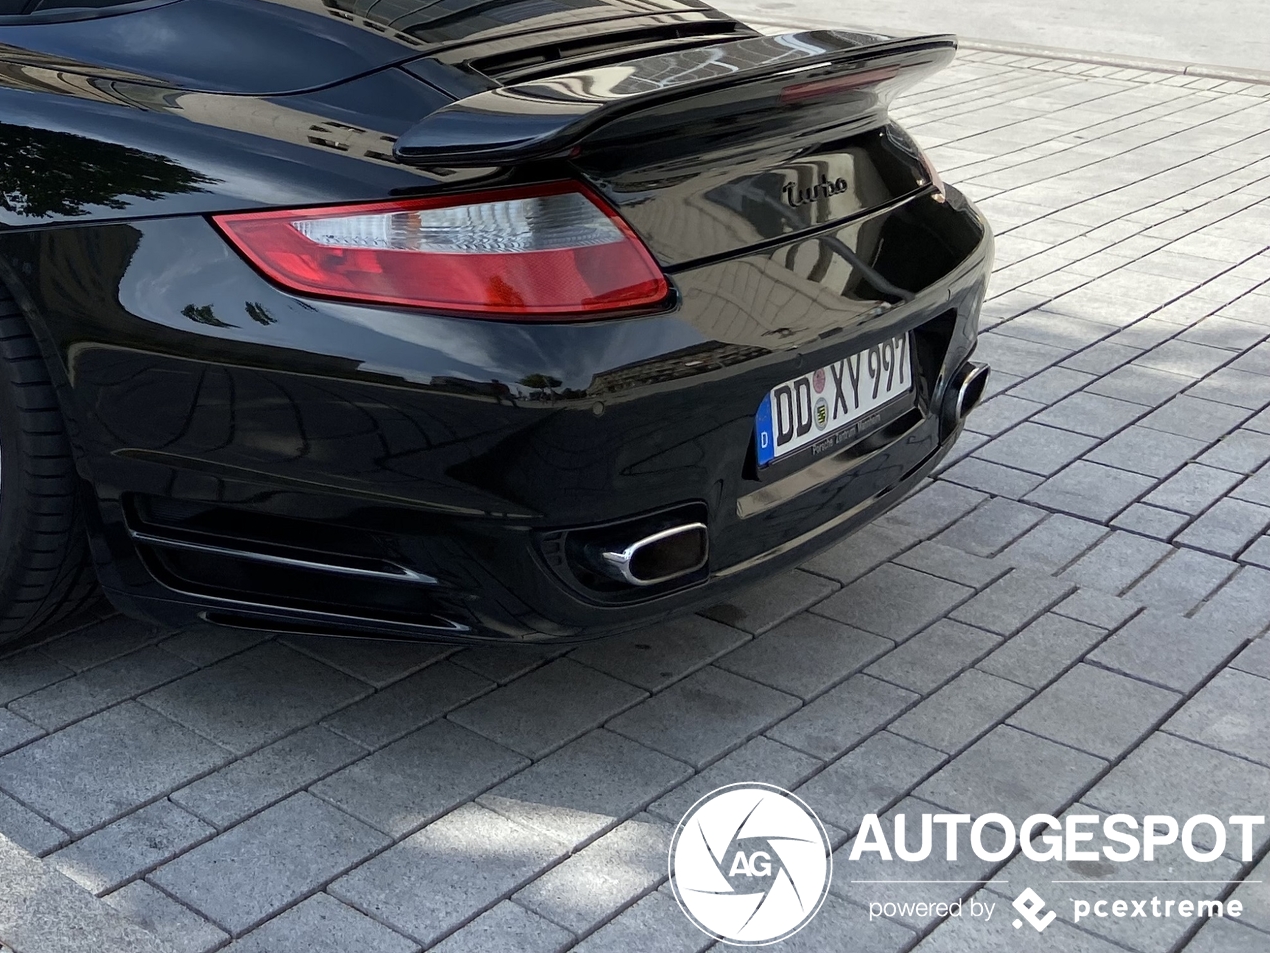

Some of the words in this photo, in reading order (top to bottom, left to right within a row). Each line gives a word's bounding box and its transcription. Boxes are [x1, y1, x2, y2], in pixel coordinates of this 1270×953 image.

[782, 174, 848, 208] Turbo
[774, 376, 813, 447] DD
[830, 353, 861, 420] XY
[868, 332, 907, 400] 997
[761, 431, 769, 449] D
